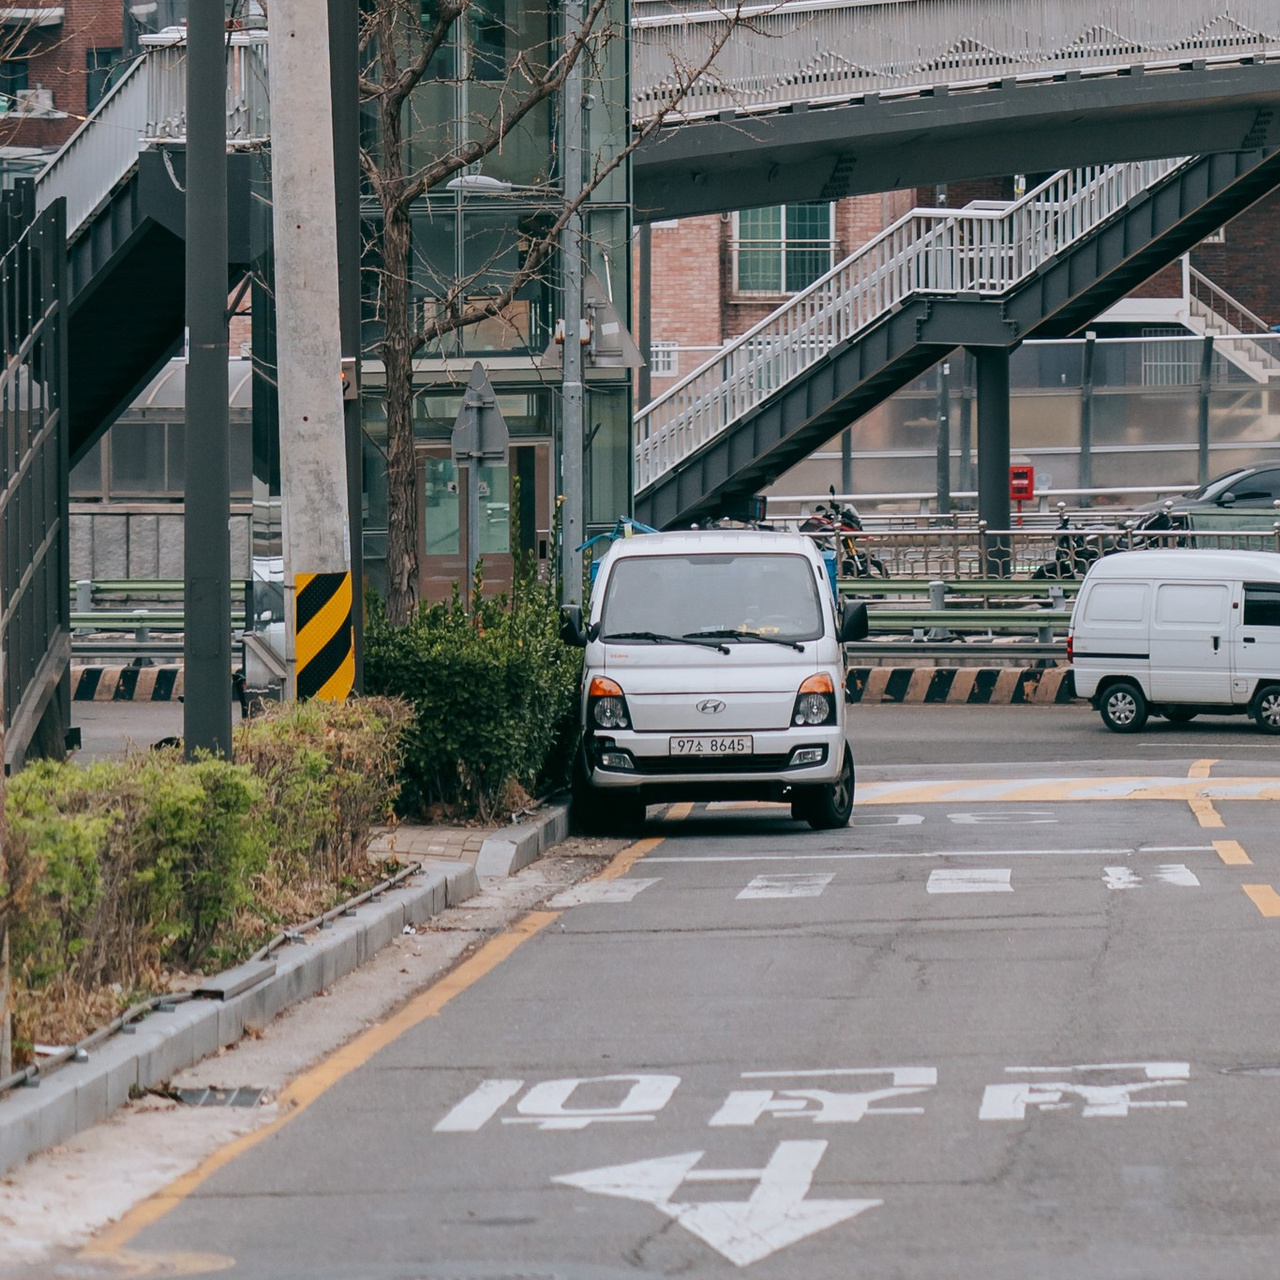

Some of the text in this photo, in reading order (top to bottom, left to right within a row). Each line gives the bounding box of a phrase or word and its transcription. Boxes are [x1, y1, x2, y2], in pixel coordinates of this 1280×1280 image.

[677, 739, 745, 753] 97소 8645
[432, 1062, 1191, 1133] 천천히
